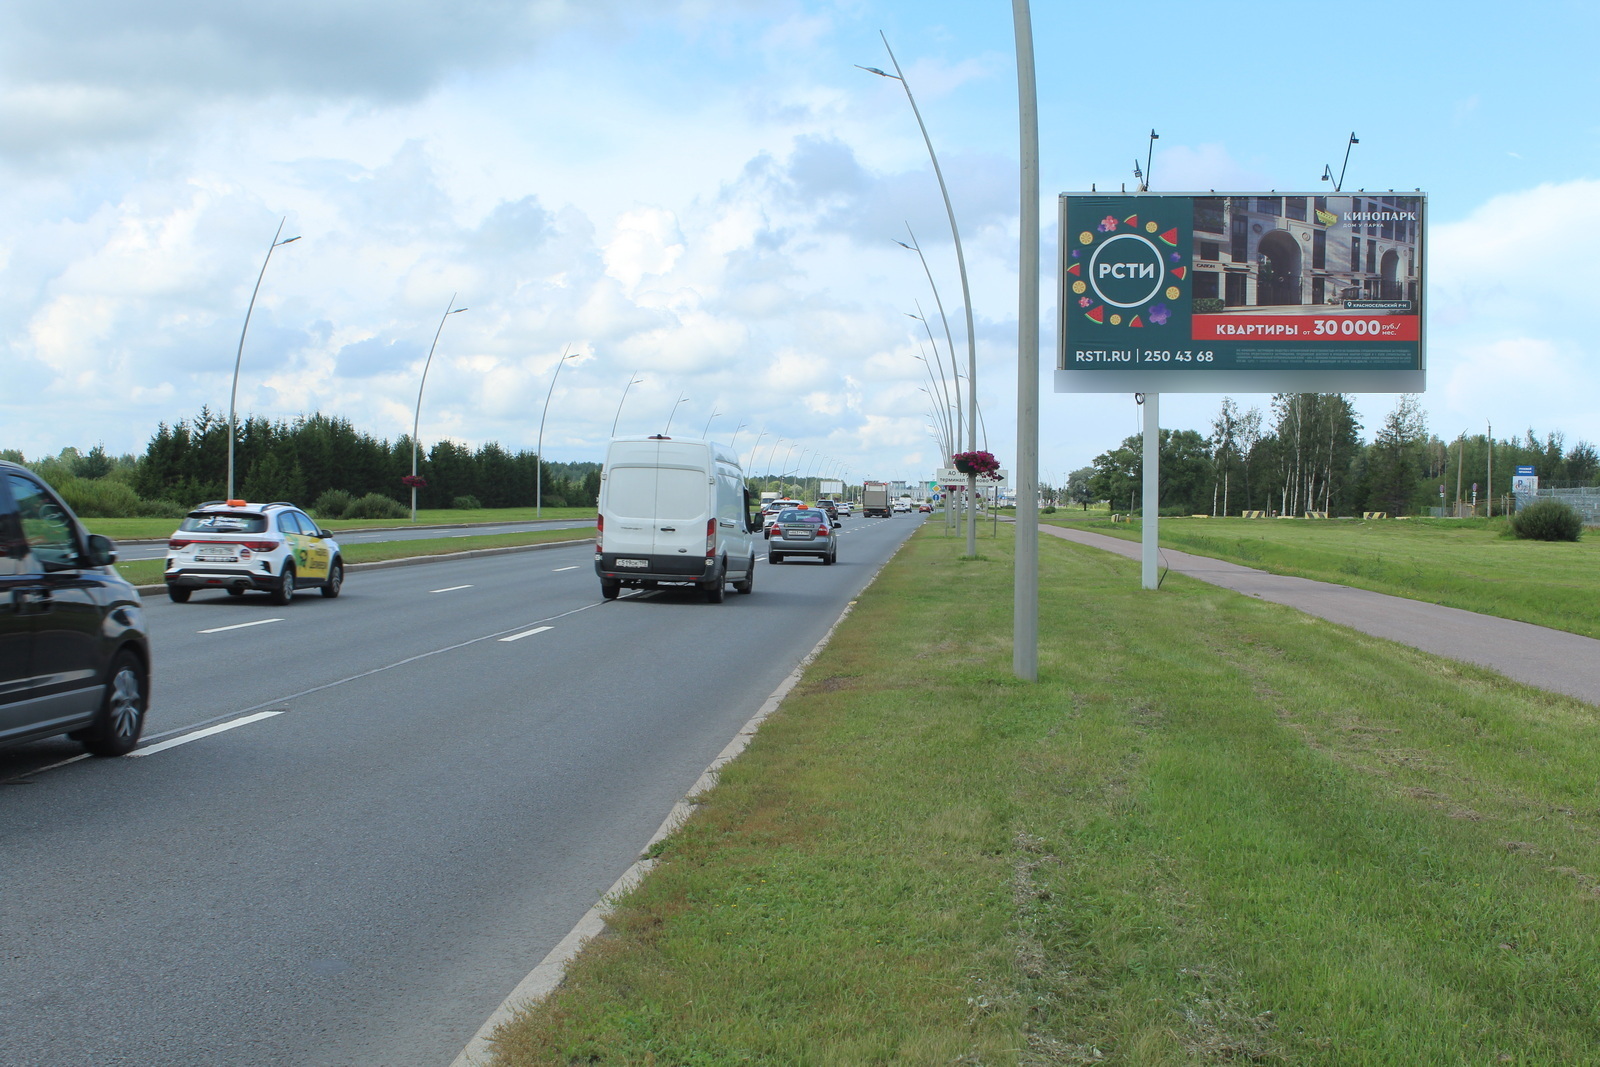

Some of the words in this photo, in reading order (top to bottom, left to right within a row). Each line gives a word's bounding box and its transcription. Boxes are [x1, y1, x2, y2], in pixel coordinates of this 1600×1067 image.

[1343, 211, 1416, 221] КИНОПАРК
[1099, 263, 1154, 279] РСТИ
[1216, 324, 1298, 335] КВАРТИРЫ
[1313, 320, 1338, 335] 30
[1341, 320, 1381, 335] 000
[1075, 350, 1131, 362] RSTI.RU
[1144, 350, 1171, 362] 250
[1174, 350, 1192, 362] 43
[1196, 350, 1214, 362] 68
